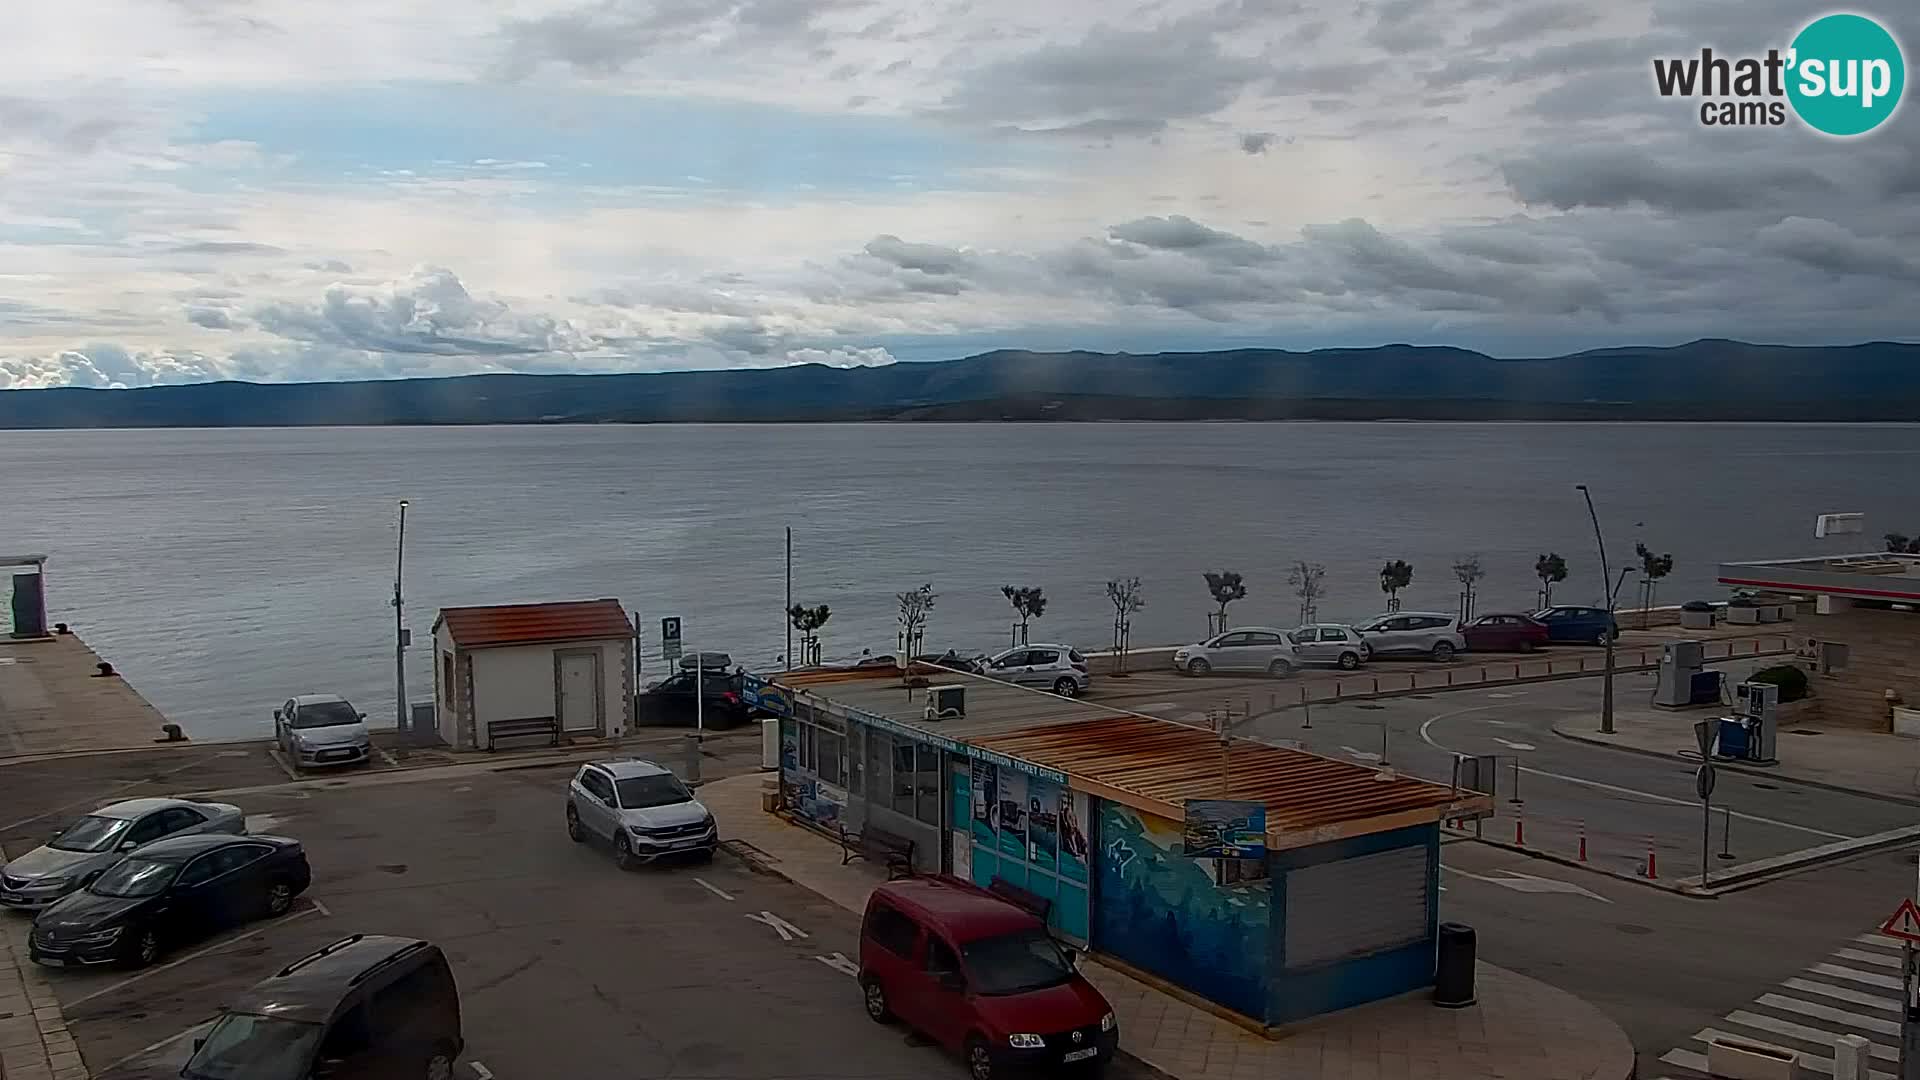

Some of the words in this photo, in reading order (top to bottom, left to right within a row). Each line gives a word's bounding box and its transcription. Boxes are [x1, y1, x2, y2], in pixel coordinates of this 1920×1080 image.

[667, 621, 677, 637] P
[967, 746, 981, 758] BUS
[982, 749, 1012, 768] STATION
[1014, 757, 1038, 776] TICKET
[1039, 766, 1065, 784] OFFICE
